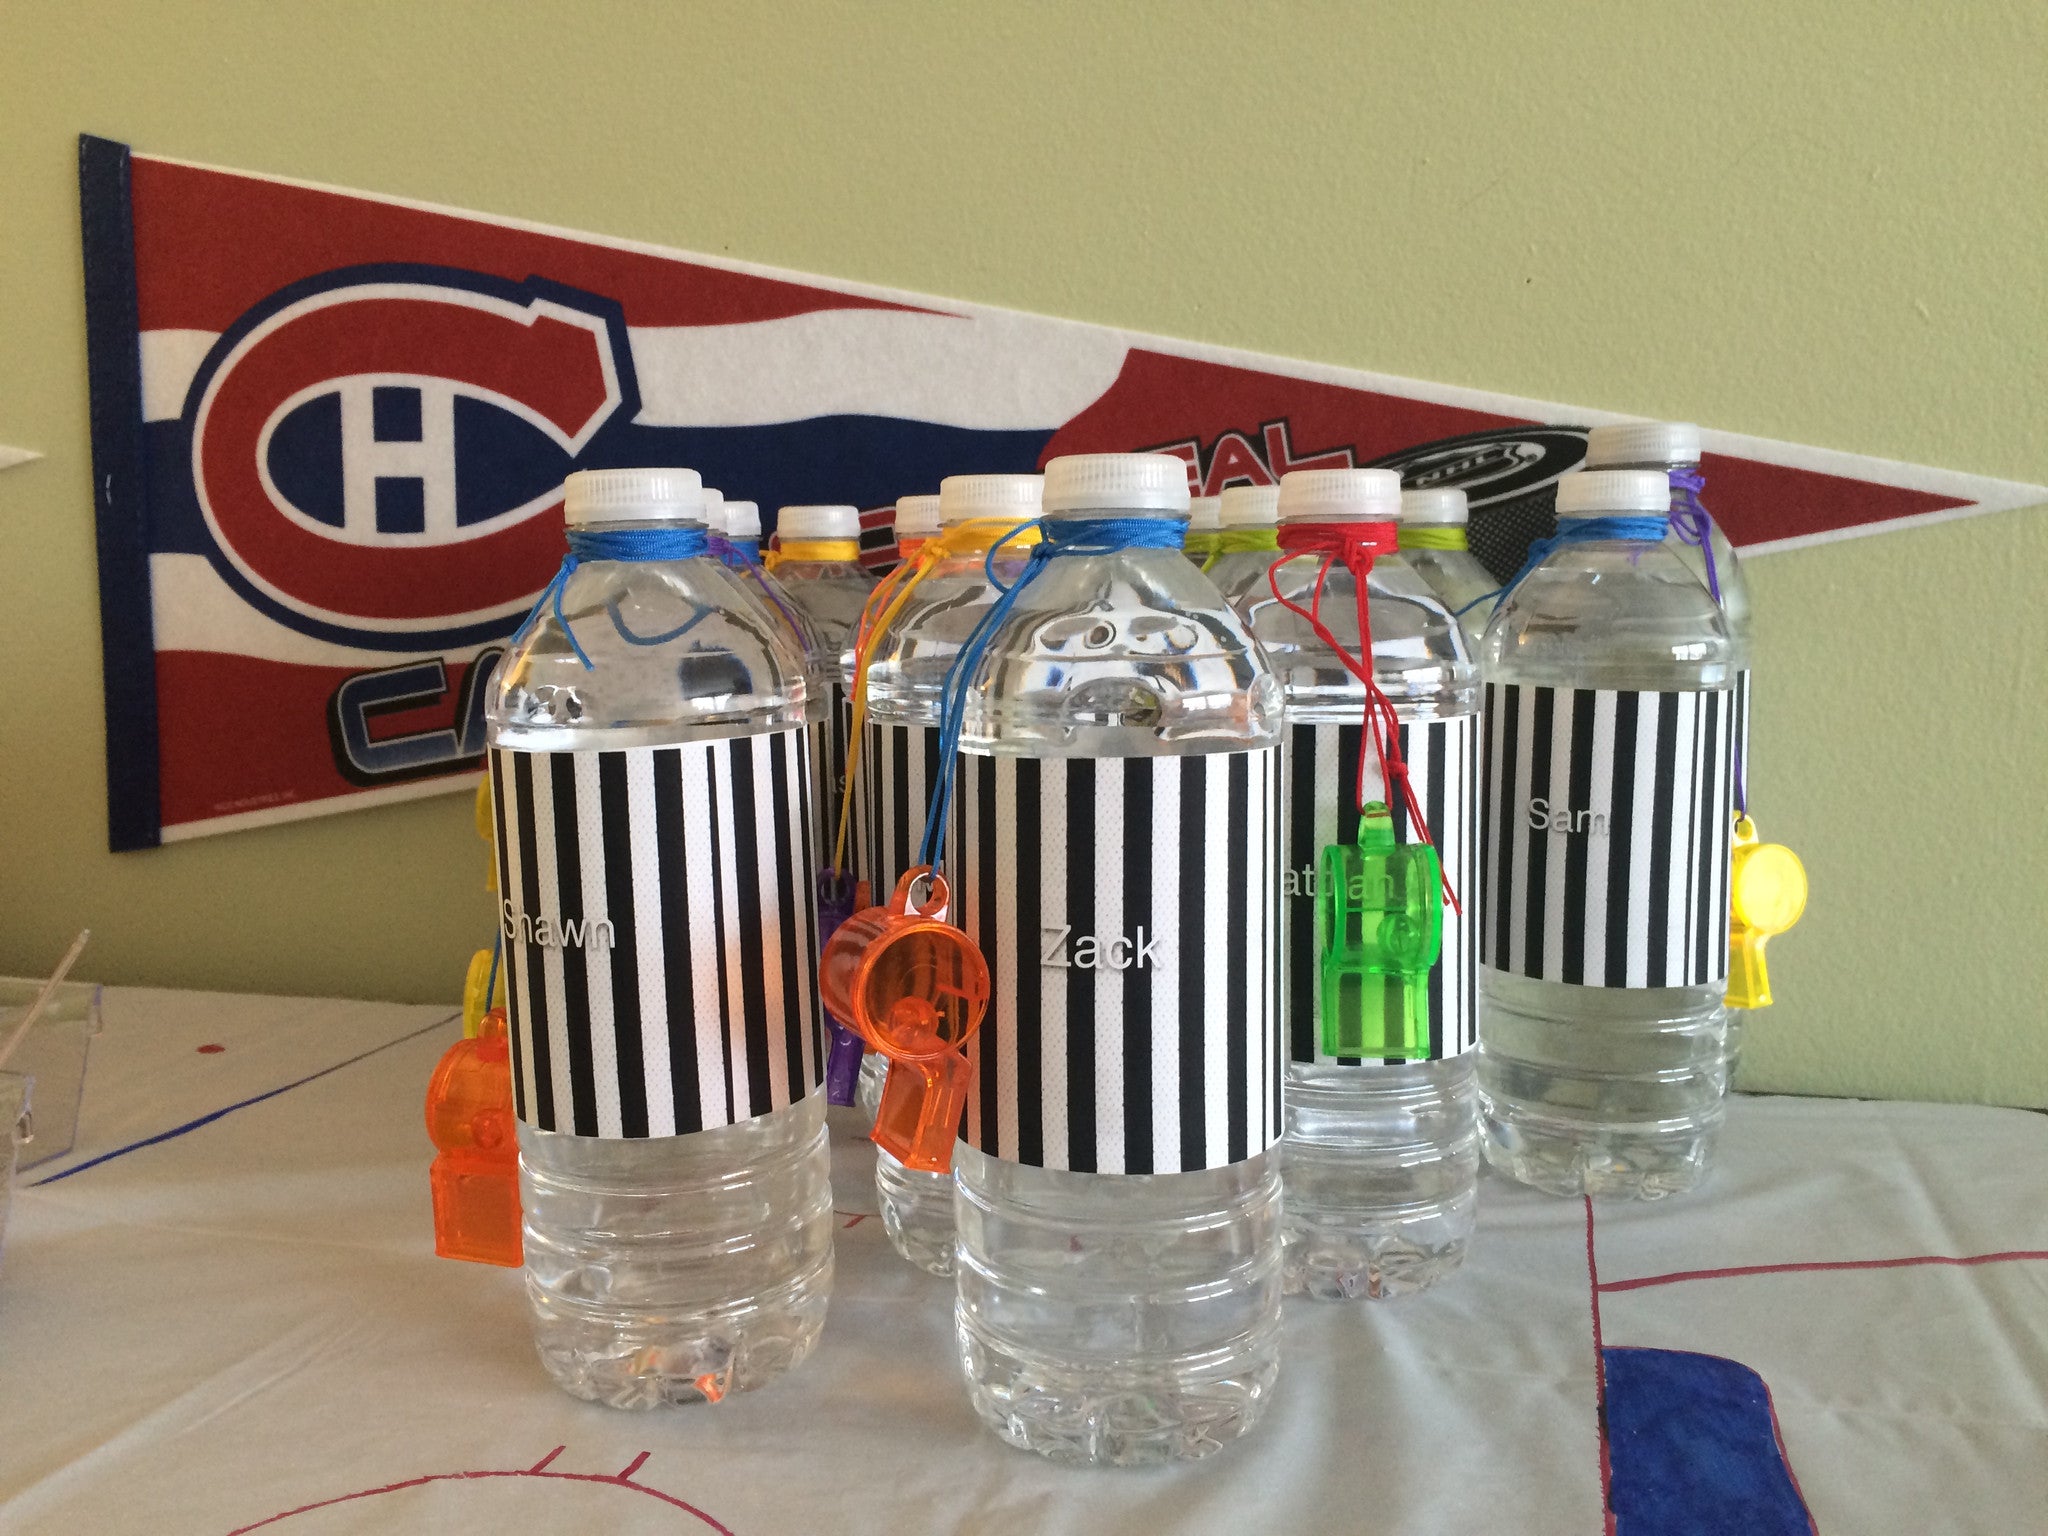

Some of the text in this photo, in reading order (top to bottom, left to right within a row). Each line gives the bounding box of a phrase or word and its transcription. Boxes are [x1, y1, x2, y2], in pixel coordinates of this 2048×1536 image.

[1528, 797, 1609, 835] Sam
[1283, 862, 1396, 901] atan
[503, 898, 616, 949] Shawn
[1040, 924, 1161, 970] Zack
